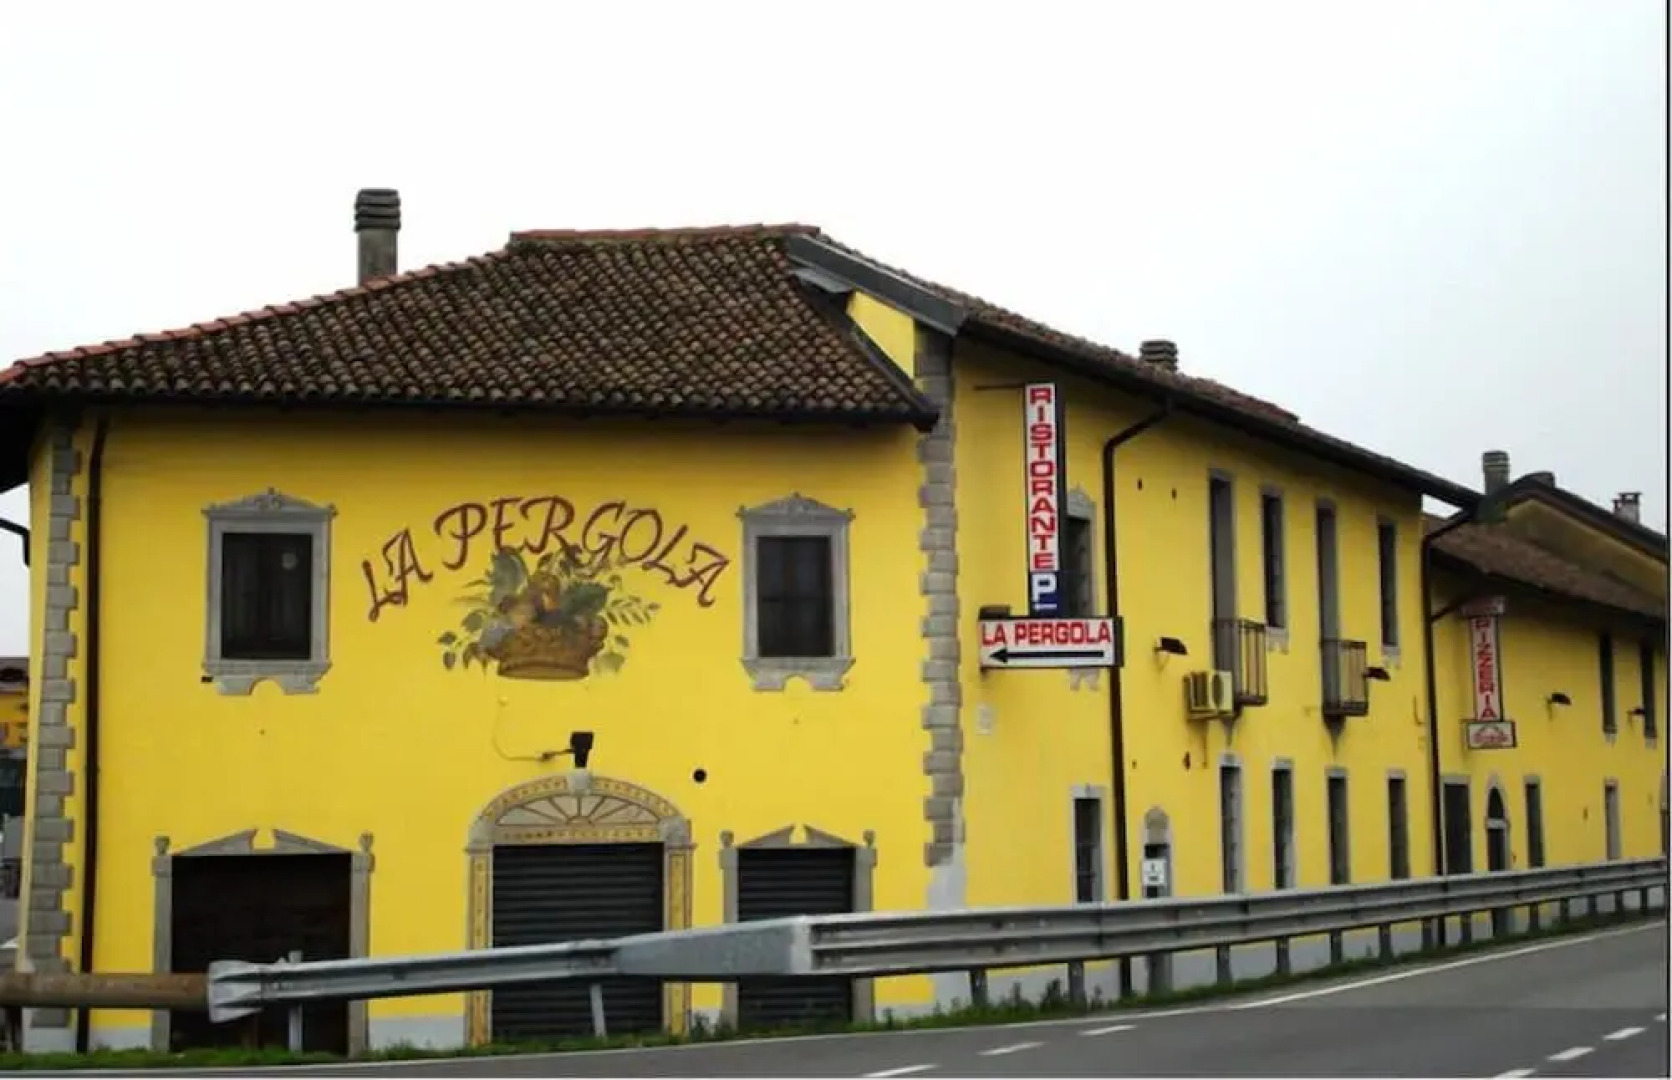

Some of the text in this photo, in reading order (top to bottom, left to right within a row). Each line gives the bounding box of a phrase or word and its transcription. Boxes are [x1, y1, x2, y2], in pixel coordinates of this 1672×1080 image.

[1029, 387, 1056, 570] RISTORANTE
[362, 495, 730, 623] LA PERGOLA
[1031, 574, 1057, 603] P
[981, 621, 1112, 646] LA PERGOLA
[1475, 619, 1497, 721] PIZZERIA
